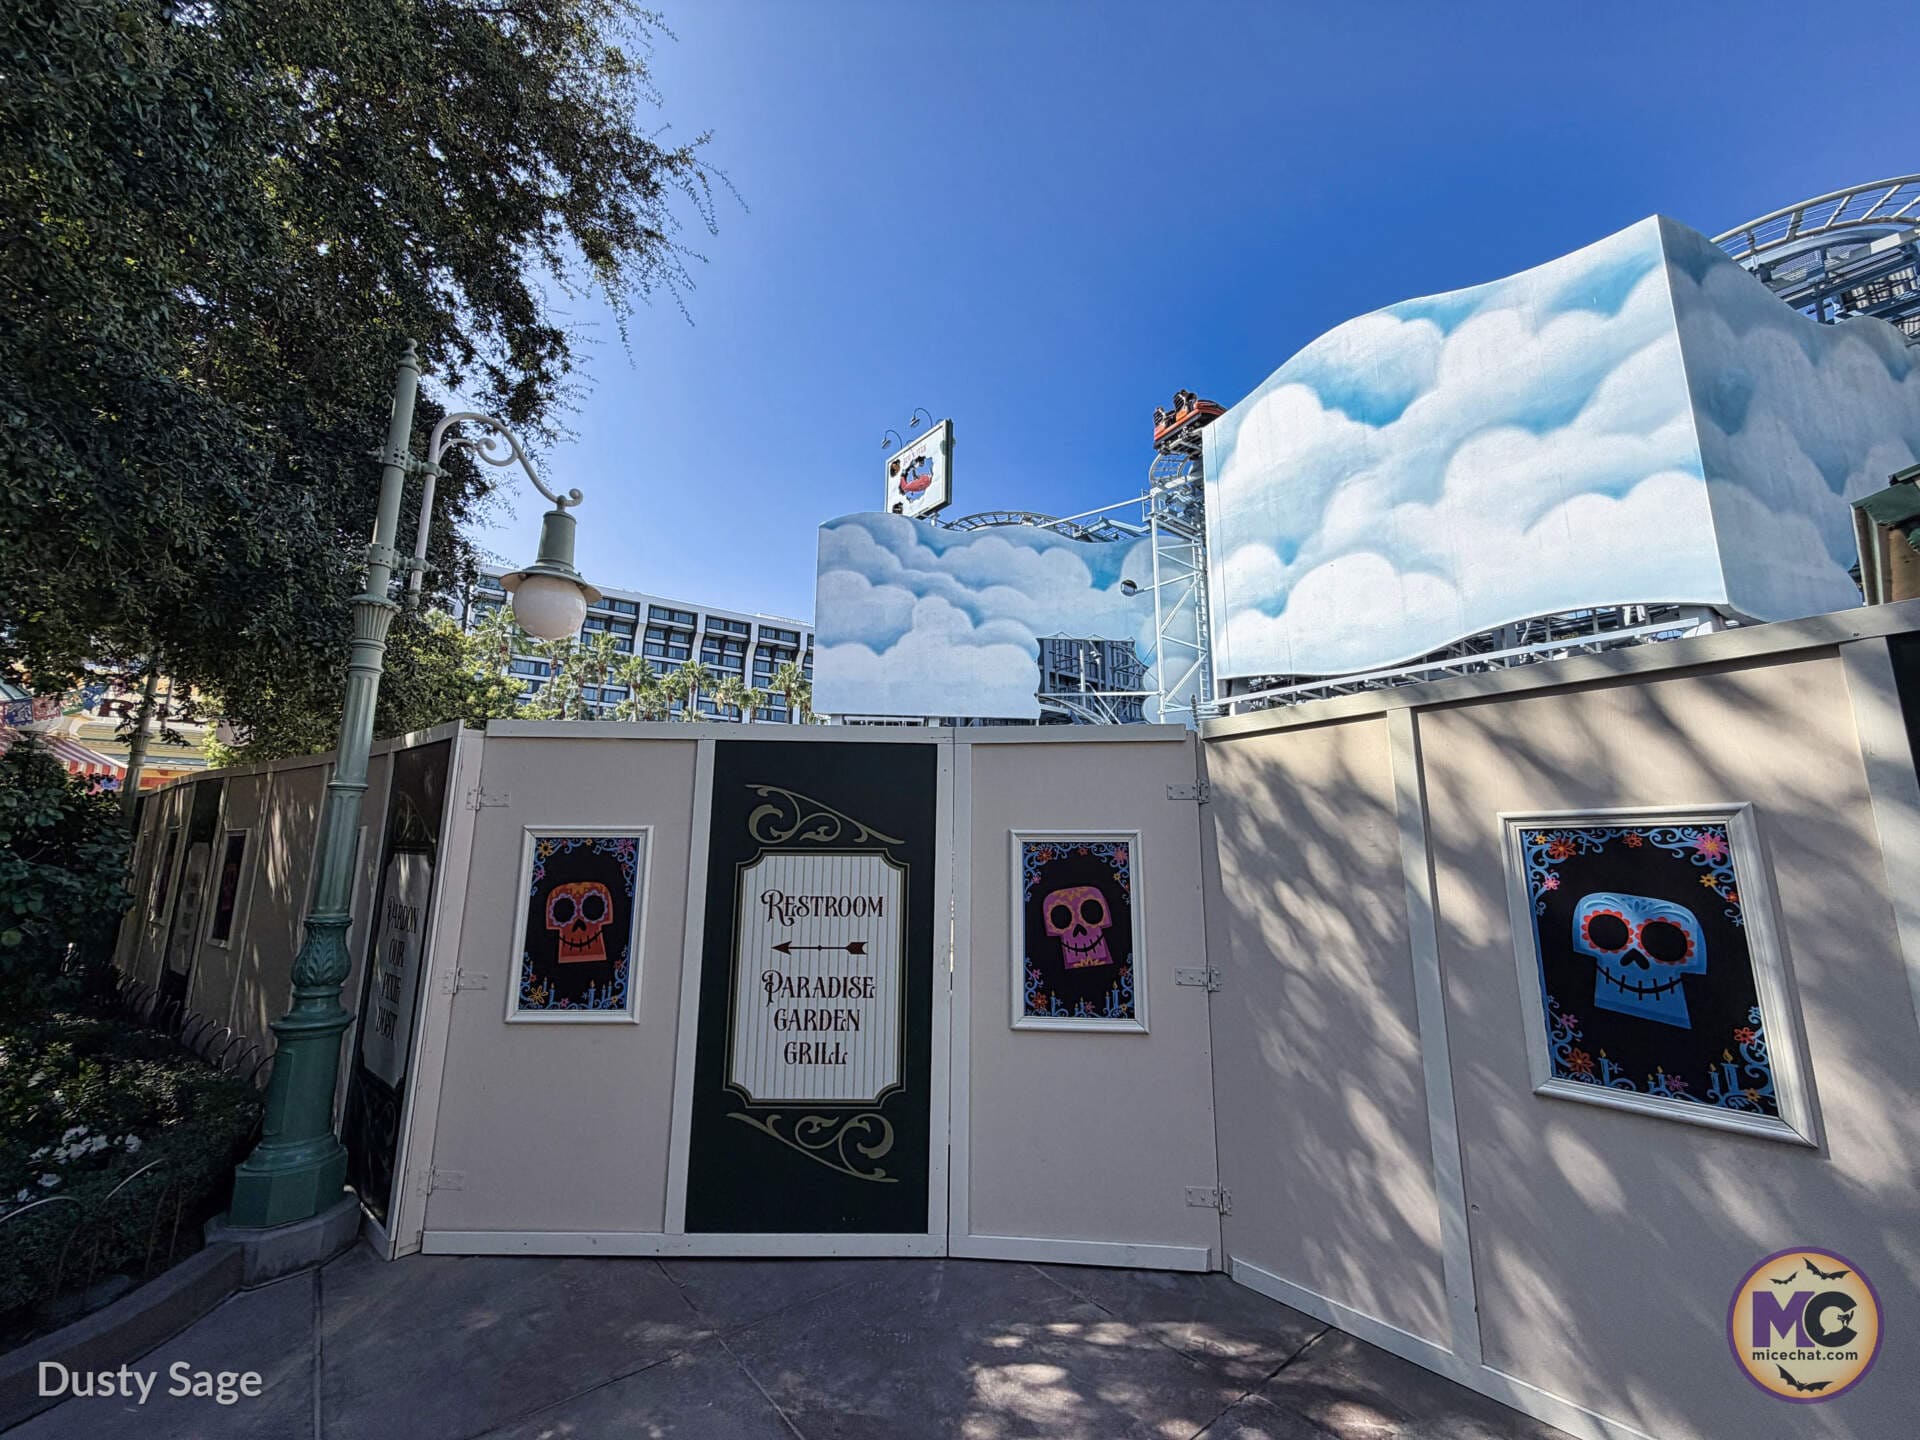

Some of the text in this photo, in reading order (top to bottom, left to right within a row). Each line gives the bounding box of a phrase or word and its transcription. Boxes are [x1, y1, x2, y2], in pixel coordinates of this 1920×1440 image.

[760, 889, 884, 926] RESTROOM
[761, 969, 876, 1007] PARADISE
[773, 1008, 861, 1031] GARDEN
[784, 1041, 848, 1065] GRILL
